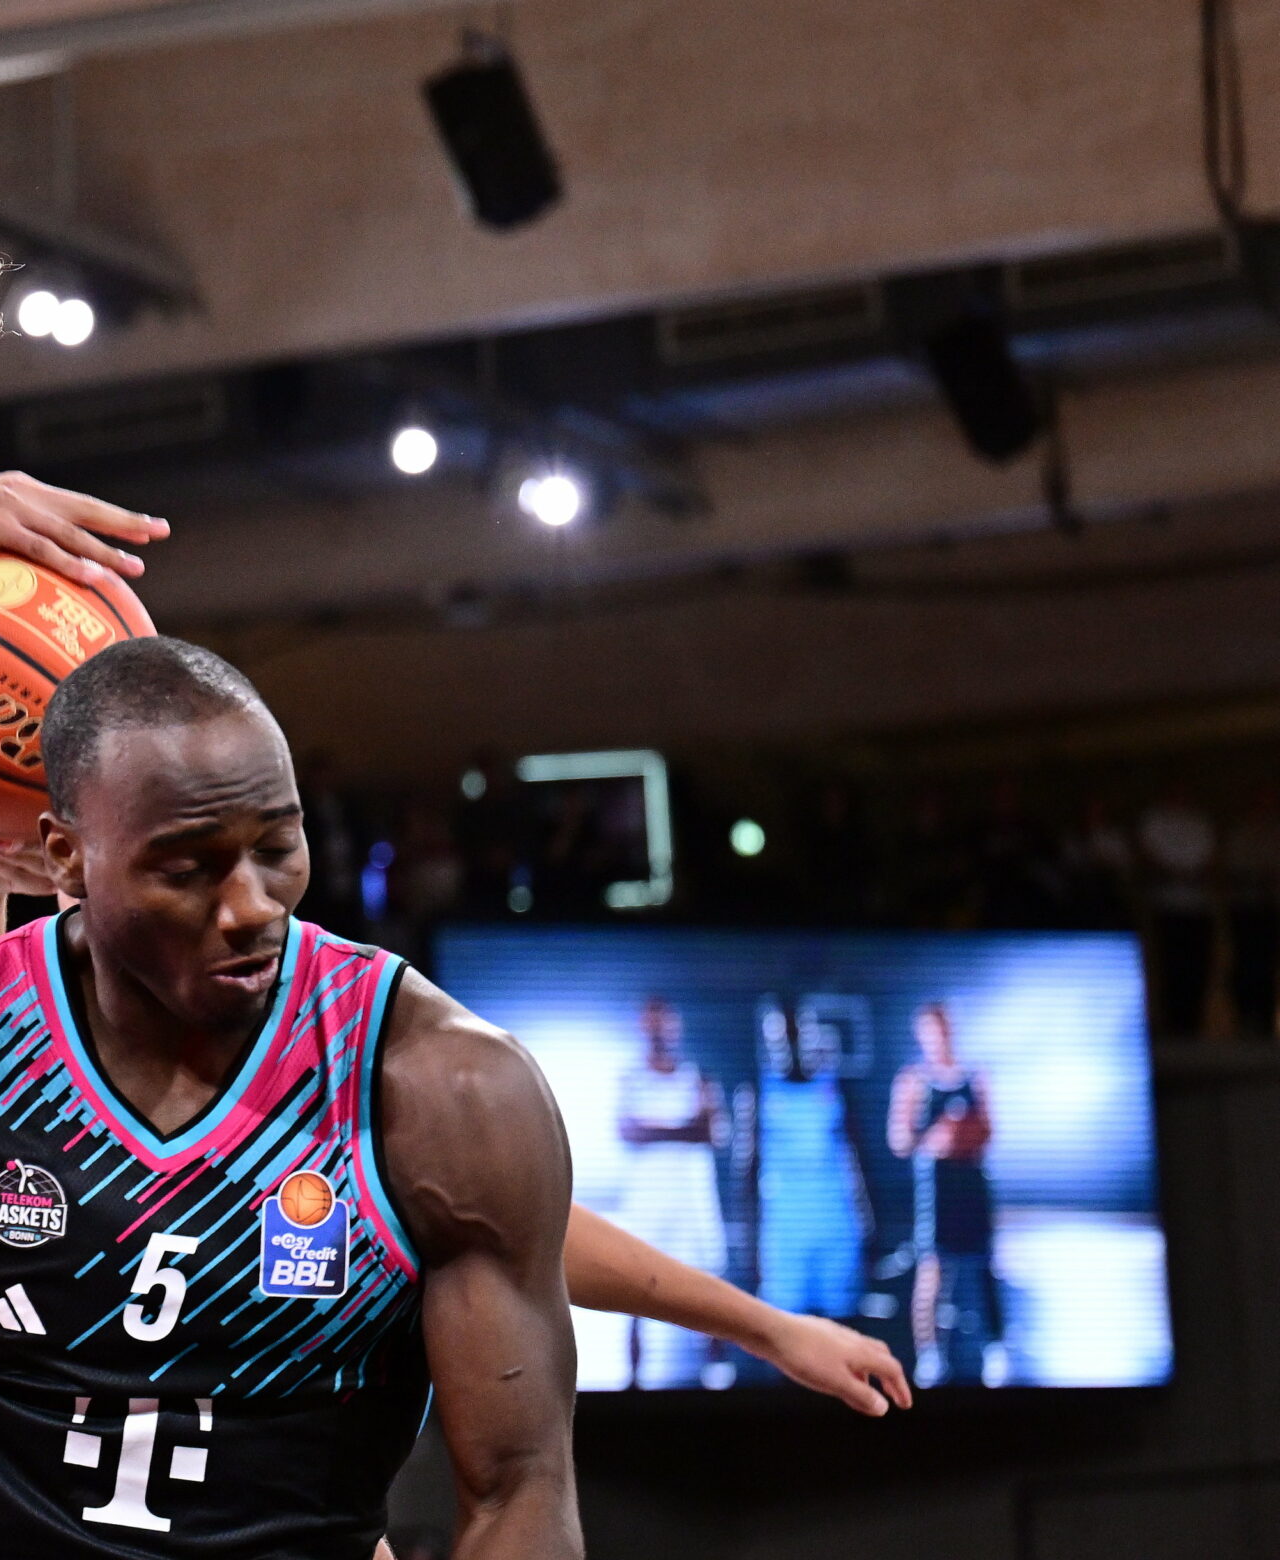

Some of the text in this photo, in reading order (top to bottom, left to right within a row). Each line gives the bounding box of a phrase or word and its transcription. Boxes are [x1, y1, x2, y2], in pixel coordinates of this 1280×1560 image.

[52, 588, 107, 642] BBL
[0, 1192, 53, 1208] TELEKOM
[9, 1230, 35, 1241] BONN
[290, 1247, 338, 1261] Credit
[269, 1259, 336, 1287] BBL
[122, 1232, 199, 1342] 5
